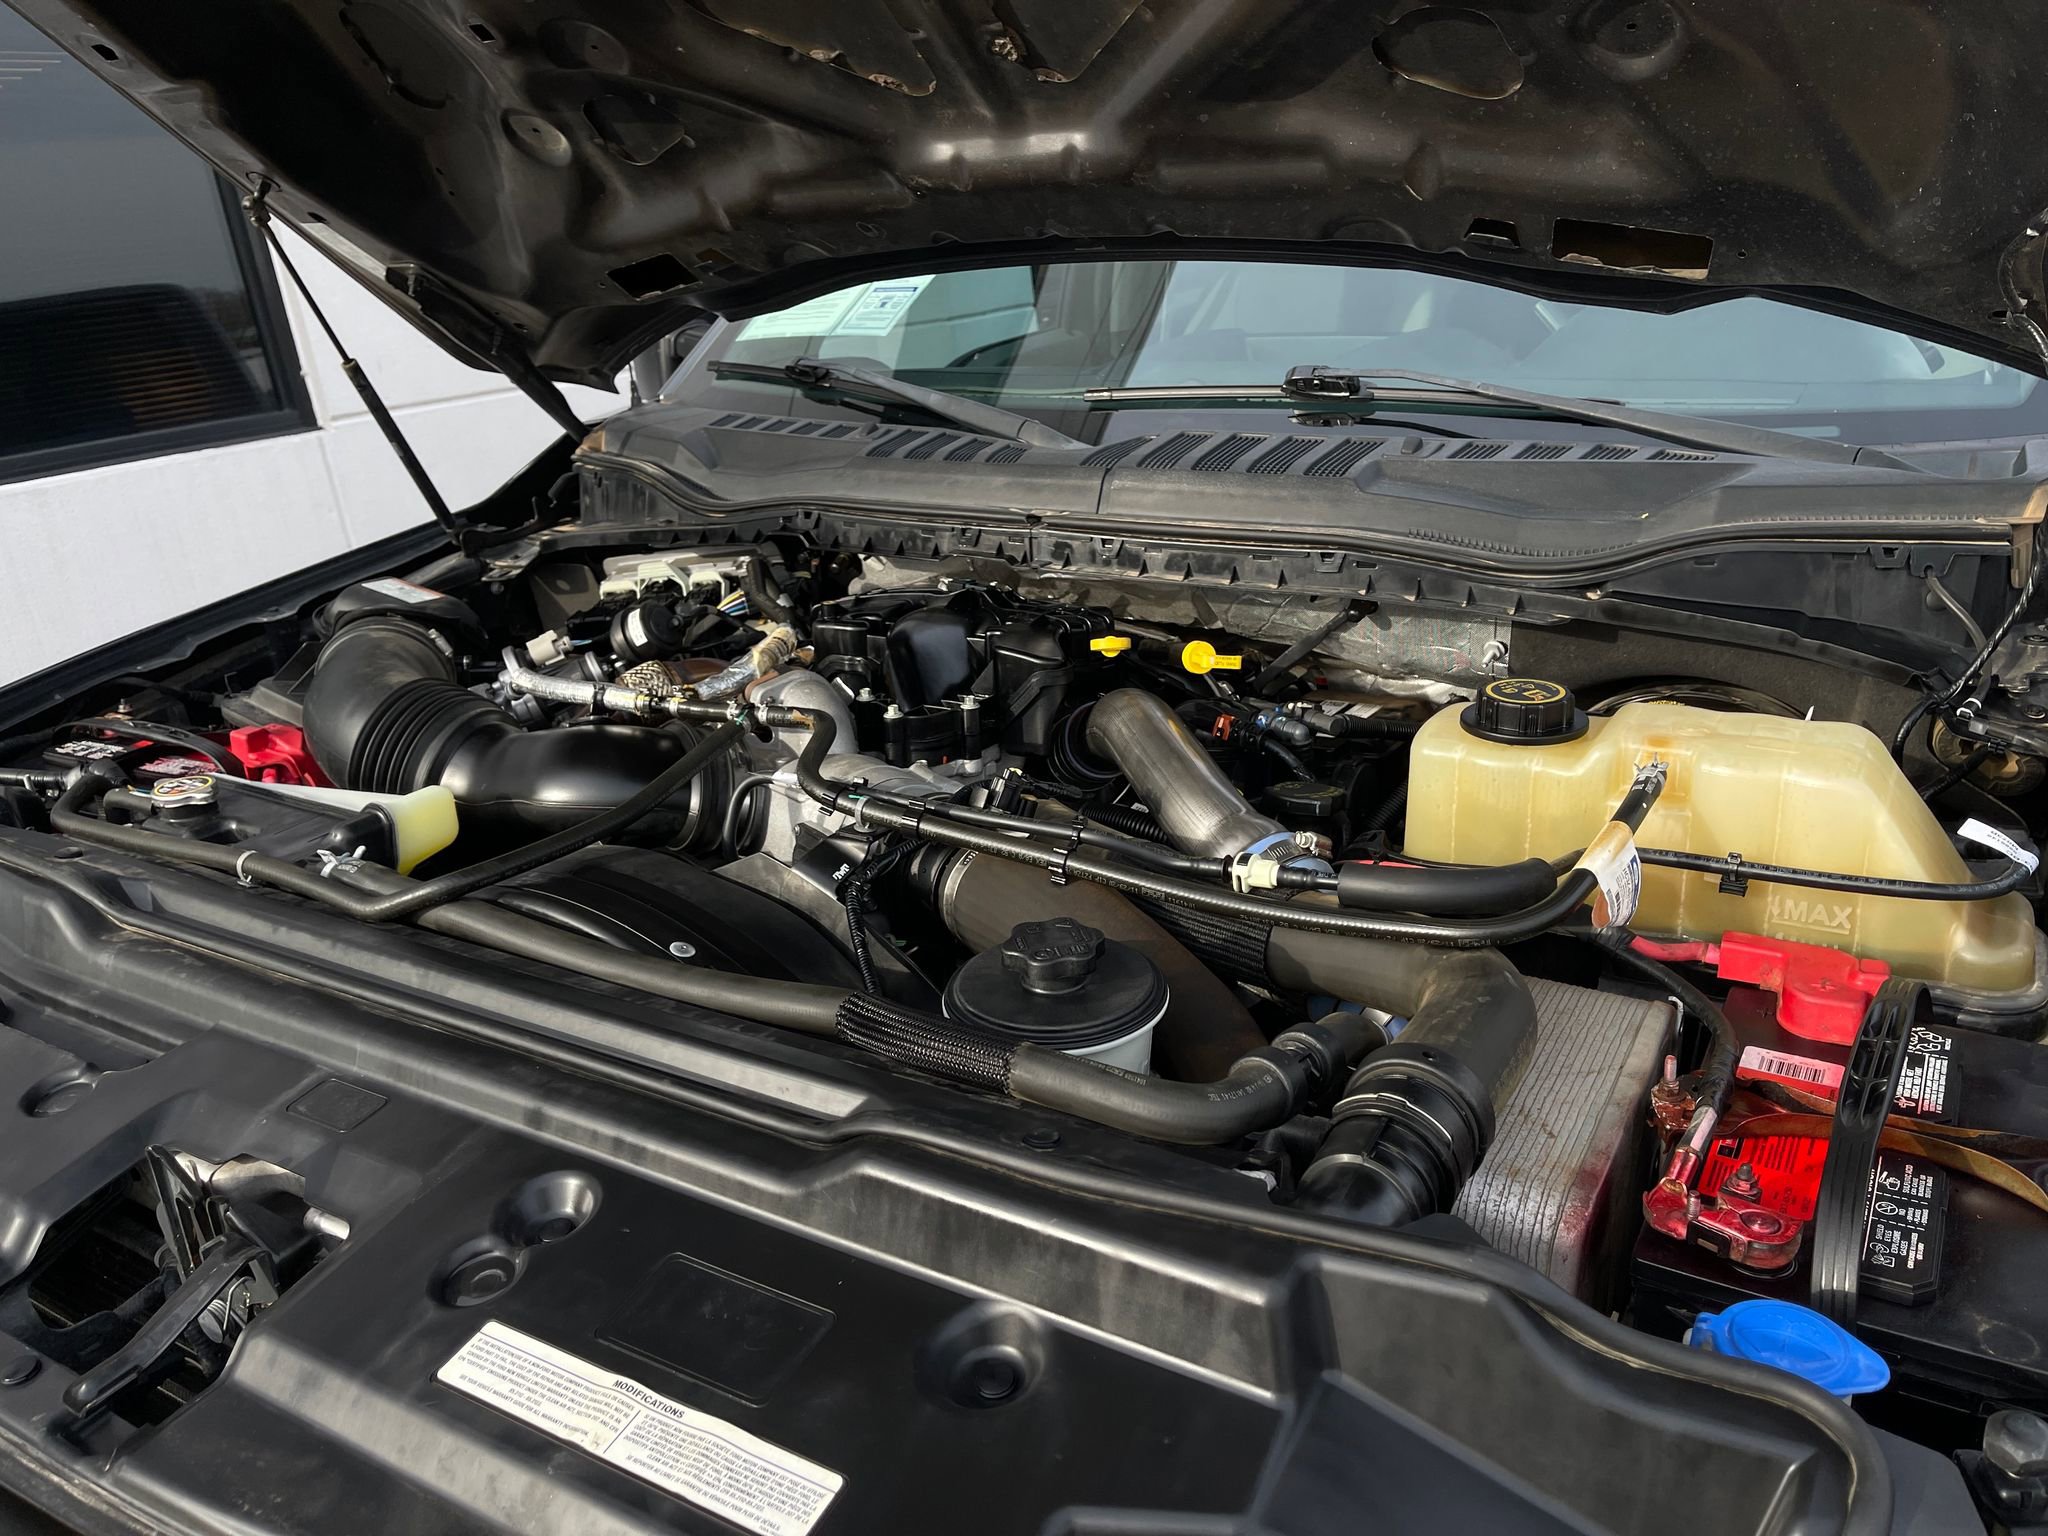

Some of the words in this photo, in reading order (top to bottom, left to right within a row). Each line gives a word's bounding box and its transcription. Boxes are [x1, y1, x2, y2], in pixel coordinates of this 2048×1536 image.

[1784, 899, 1853, 928] MAX
[1883, 1230, 1892, 1242] EYES
[612, 1380, 685, 1419] MODIFICATIONS
